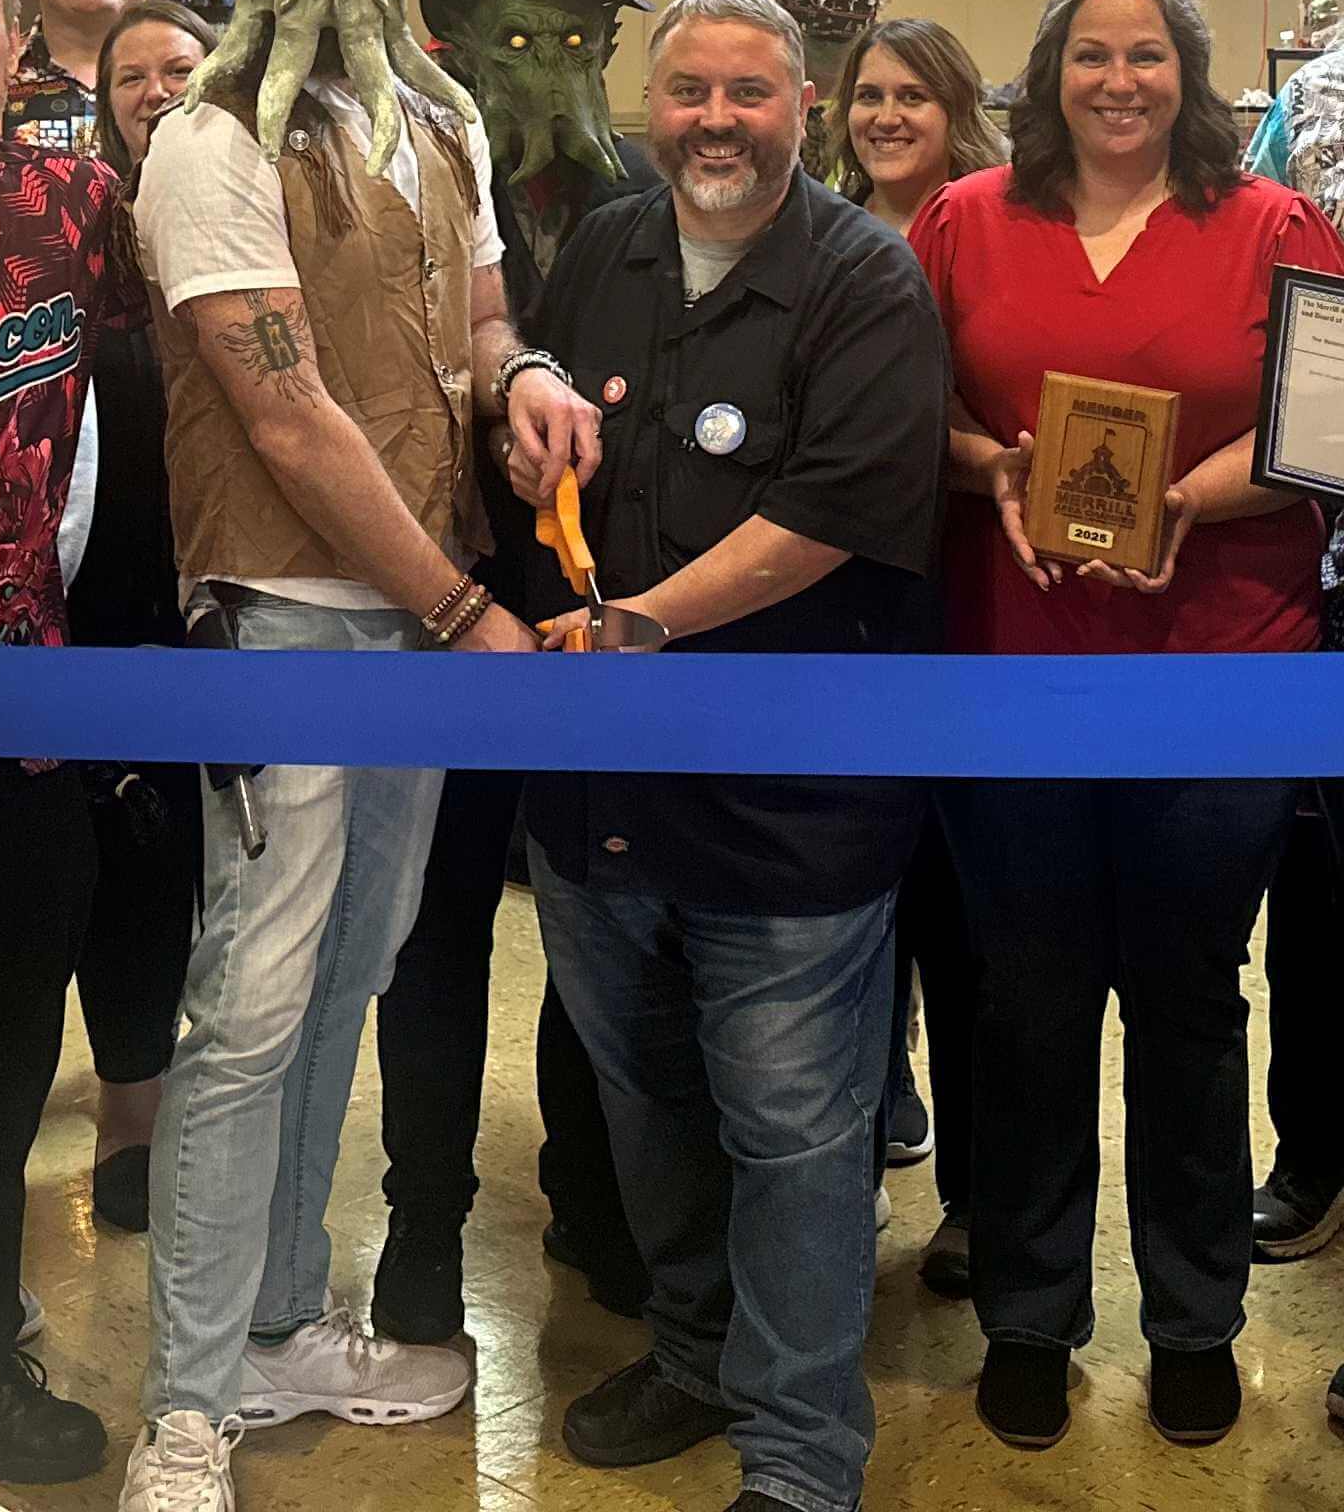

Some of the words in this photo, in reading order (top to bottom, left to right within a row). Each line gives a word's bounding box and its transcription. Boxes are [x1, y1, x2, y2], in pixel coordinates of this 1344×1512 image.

[1072, 399, 1146, 422] MEMBER
[1055, 490, 1137, 515] MERRILL
[1074, 528, 1107, 543] 2025
